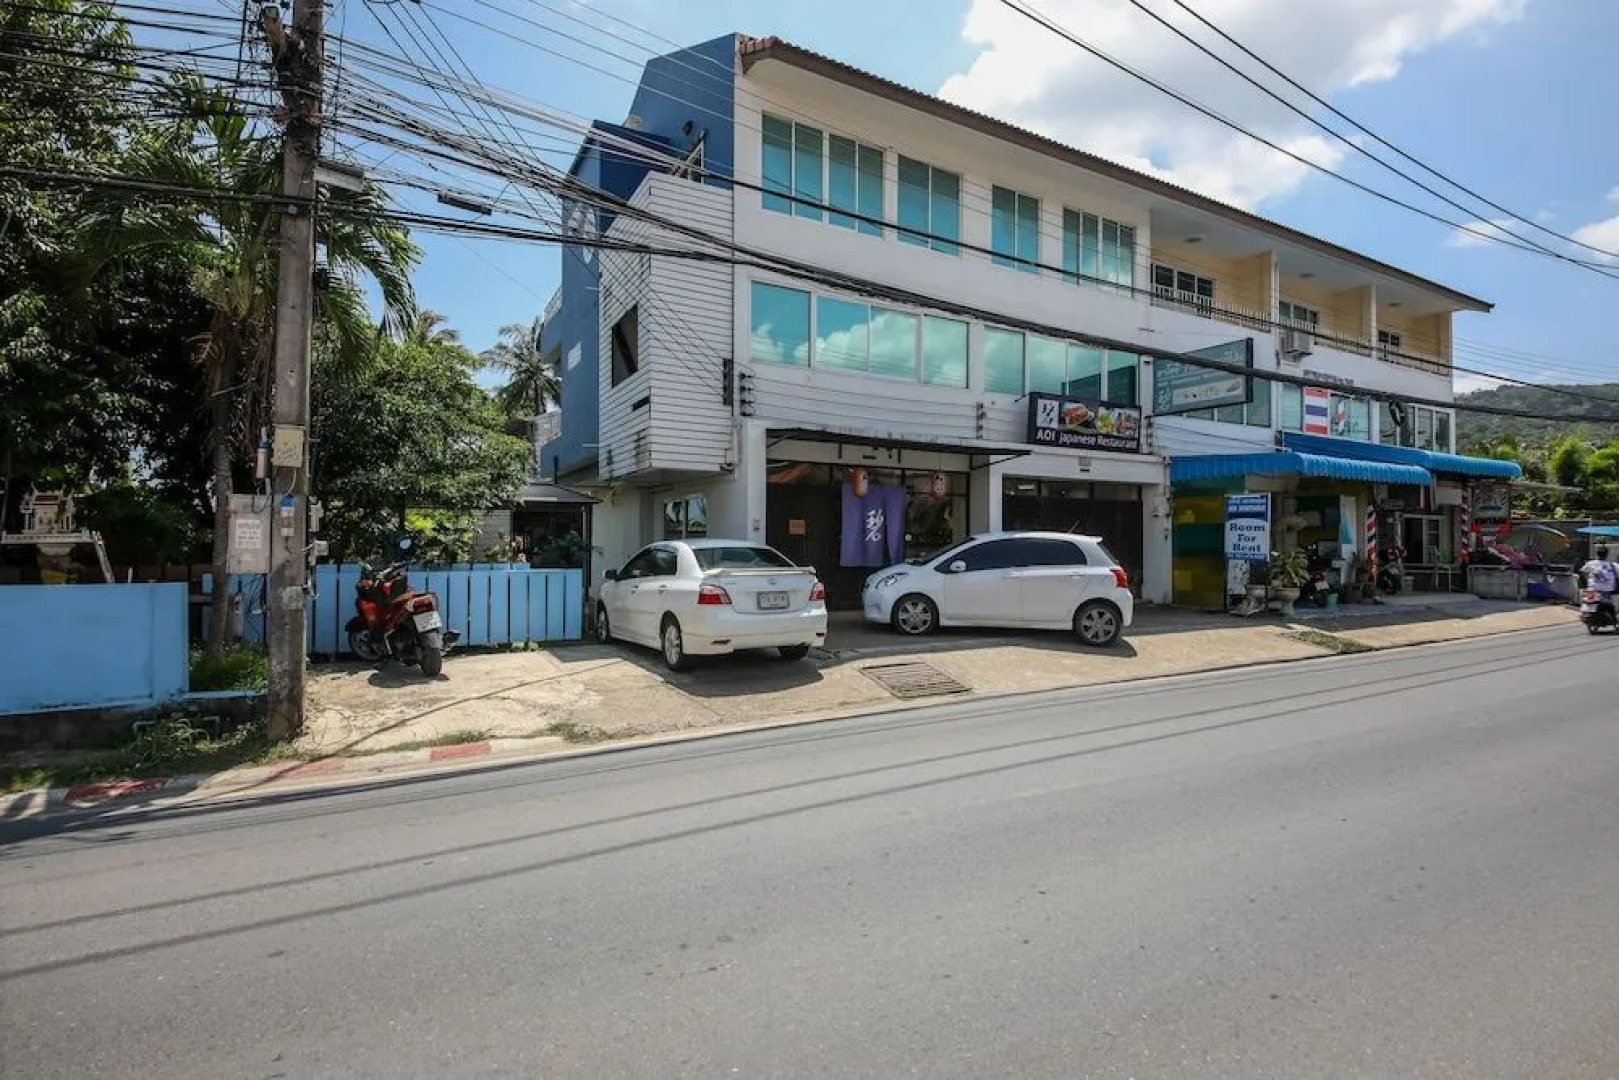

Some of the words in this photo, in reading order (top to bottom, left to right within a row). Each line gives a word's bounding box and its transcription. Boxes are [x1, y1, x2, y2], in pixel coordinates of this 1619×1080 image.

[1036, 429, 1055, 441] AOI
[1097, 434, 1138, 448] Restaurant
[1230, 522, 1265, 531] Room
[1238, 534, 1257, 543] For
[1233, 544, 1261, 552] Rent
